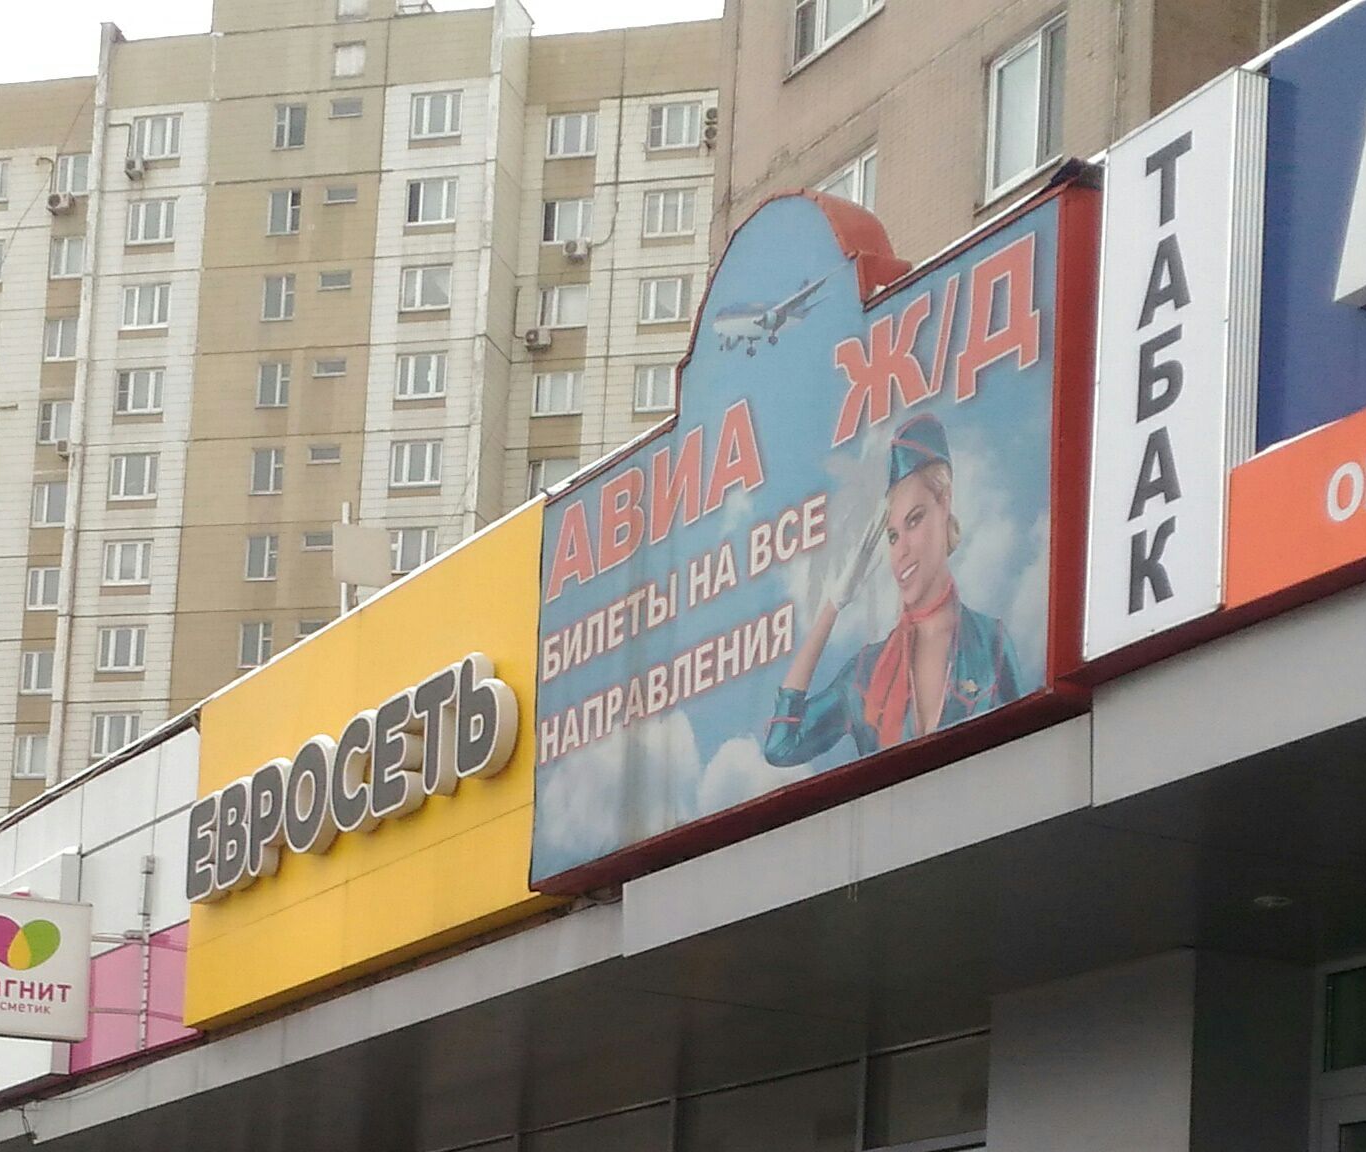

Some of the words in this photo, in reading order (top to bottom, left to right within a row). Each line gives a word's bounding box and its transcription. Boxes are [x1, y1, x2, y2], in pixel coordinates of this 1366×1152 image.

[830, 231, 1040, 448] Ж/Д
[1126, 130, 1194, 616] ТАБАК
[541, 580, 678, 684] БИЛЕТЫ
[687, 540, 739, 610] НА
[748, 492, 829, 578] ВСЕ
[544, 397, 766, 603] АВИА
[185, 651, 521, 906] ЕВРОСЕТЬ
[538, 603, 796, 765] НАПРАВЛЕНИЯ
